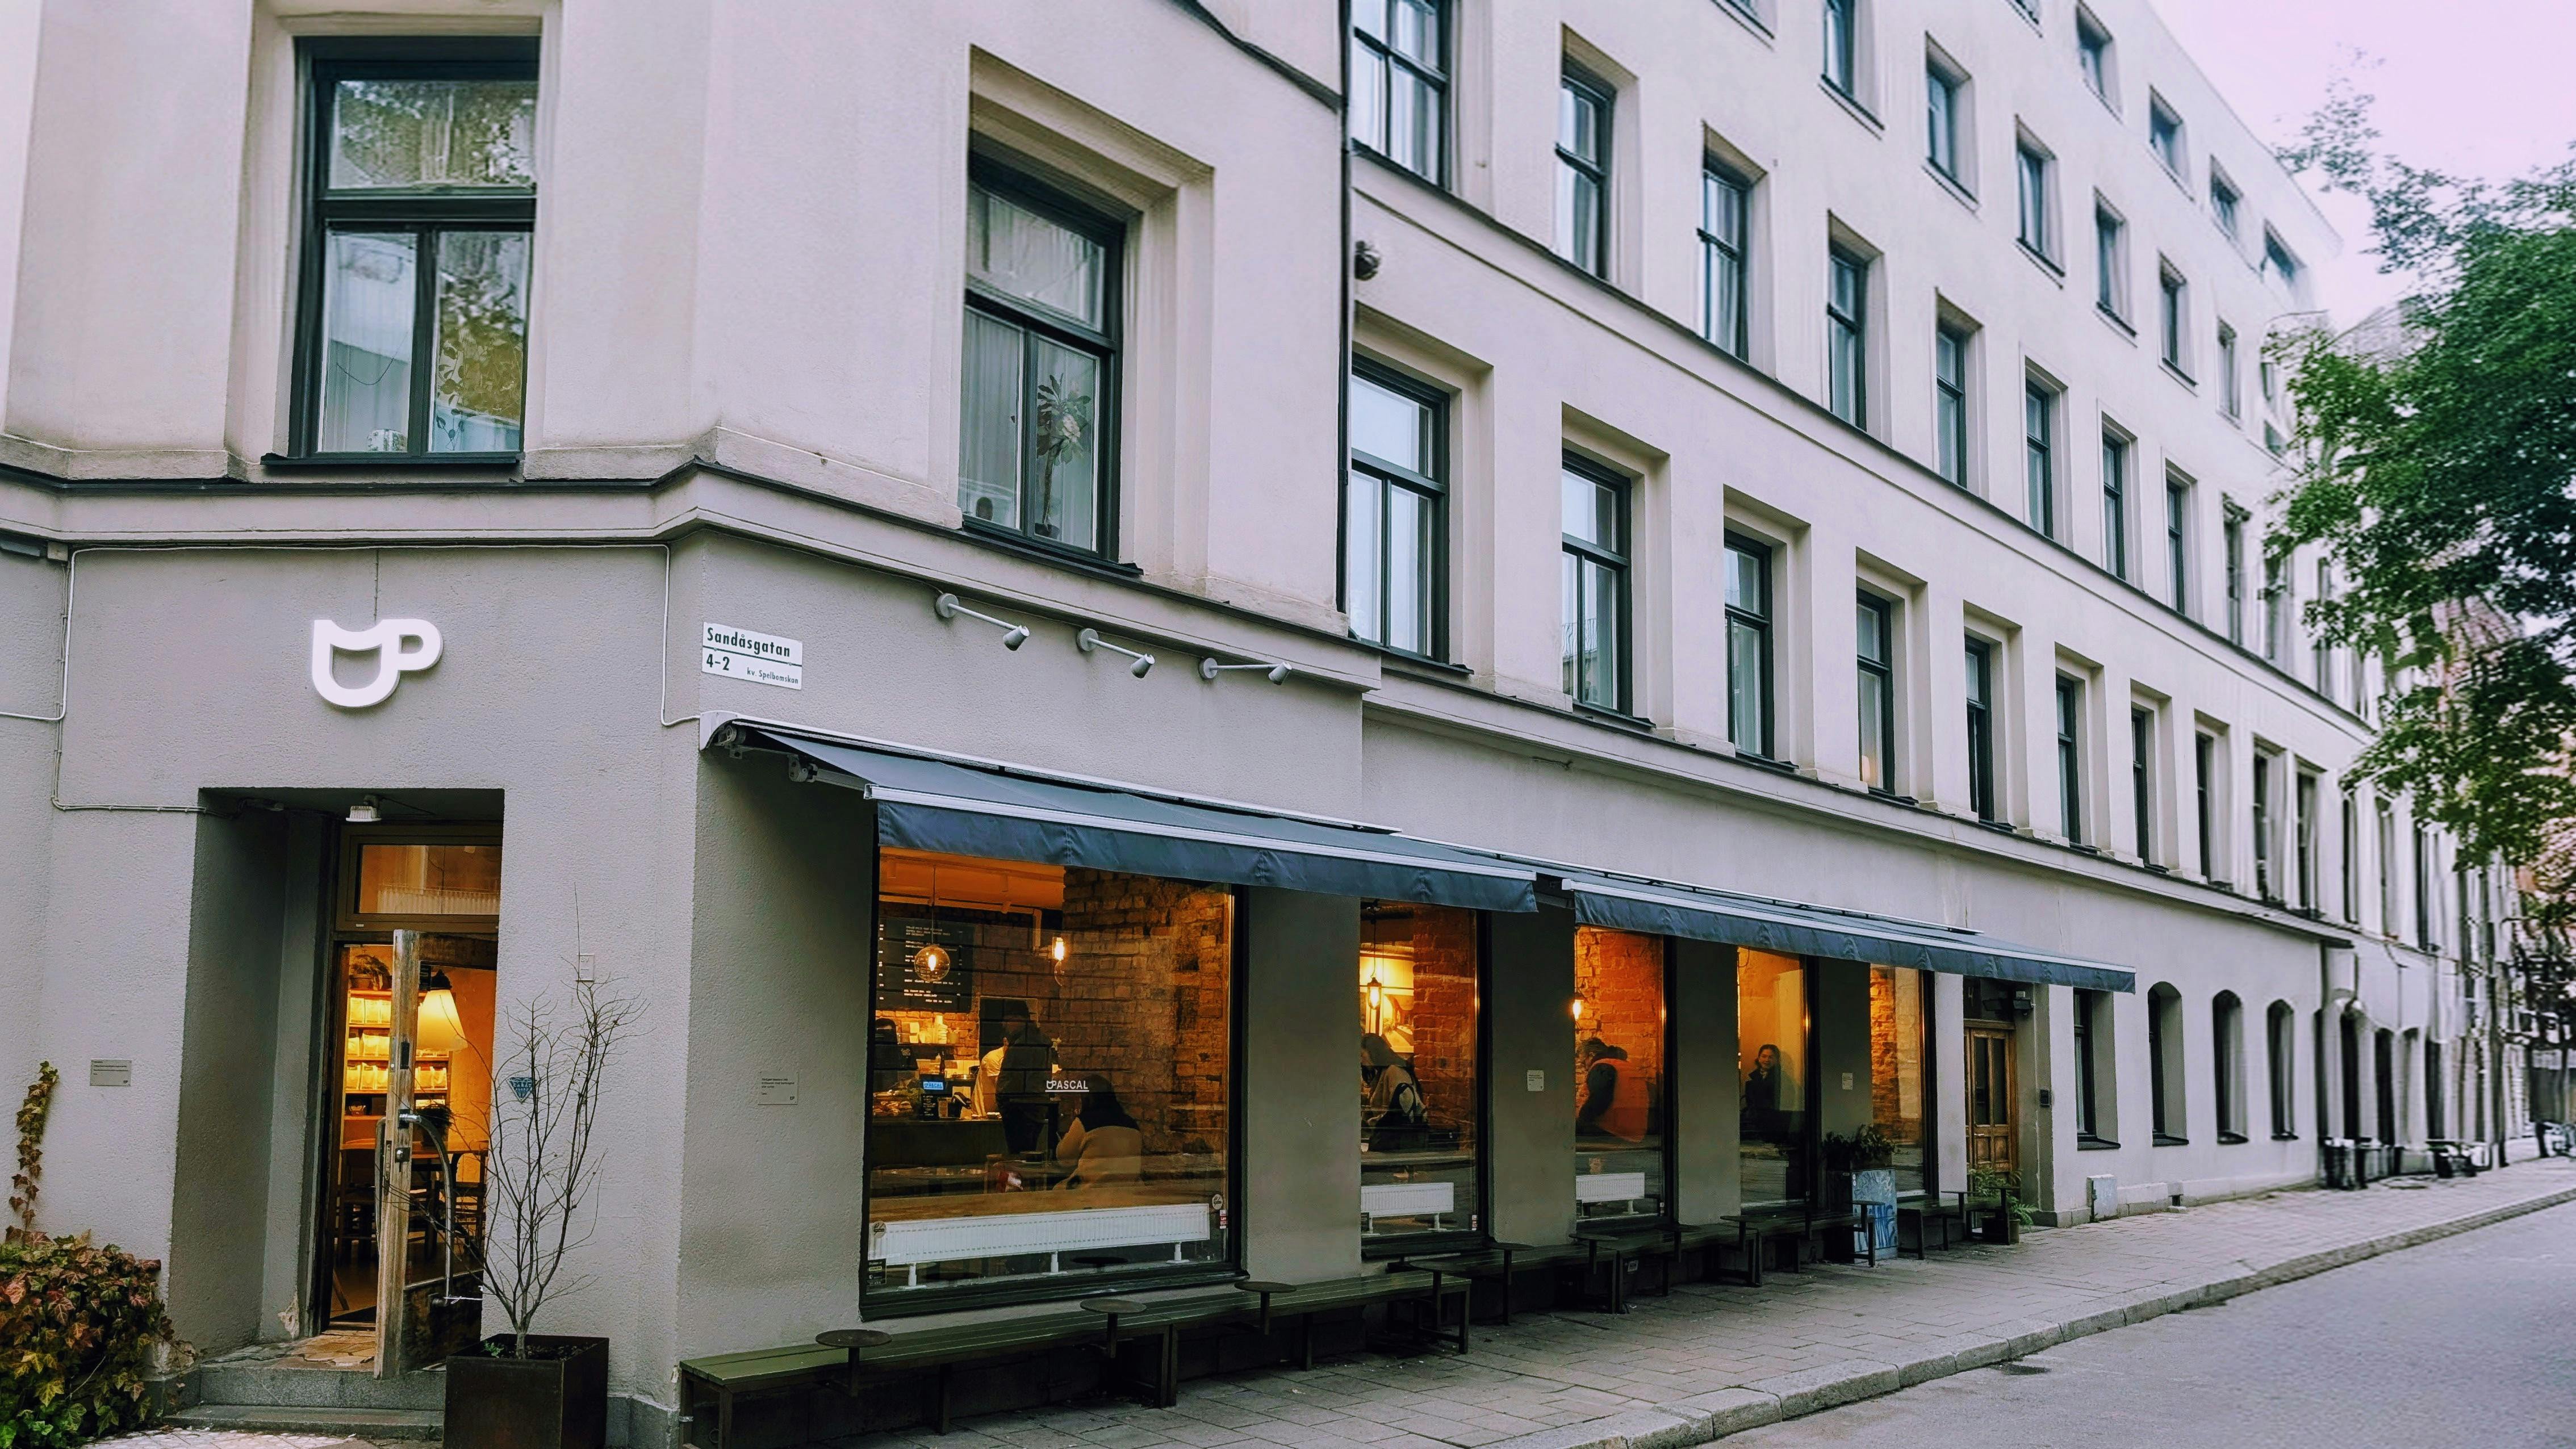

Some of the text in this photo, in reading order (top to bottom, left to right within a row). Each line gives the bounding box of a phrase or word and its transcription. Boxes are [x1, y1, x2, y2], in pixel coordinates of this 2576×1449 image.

[708, 627, 790, 657] Sandåsgatan
[706, 654, 730, 671] 4-2
[747, 667, 798, 684] kv. Spelbomskan
[1051, 1080, 1089, 1090] PASCAL
